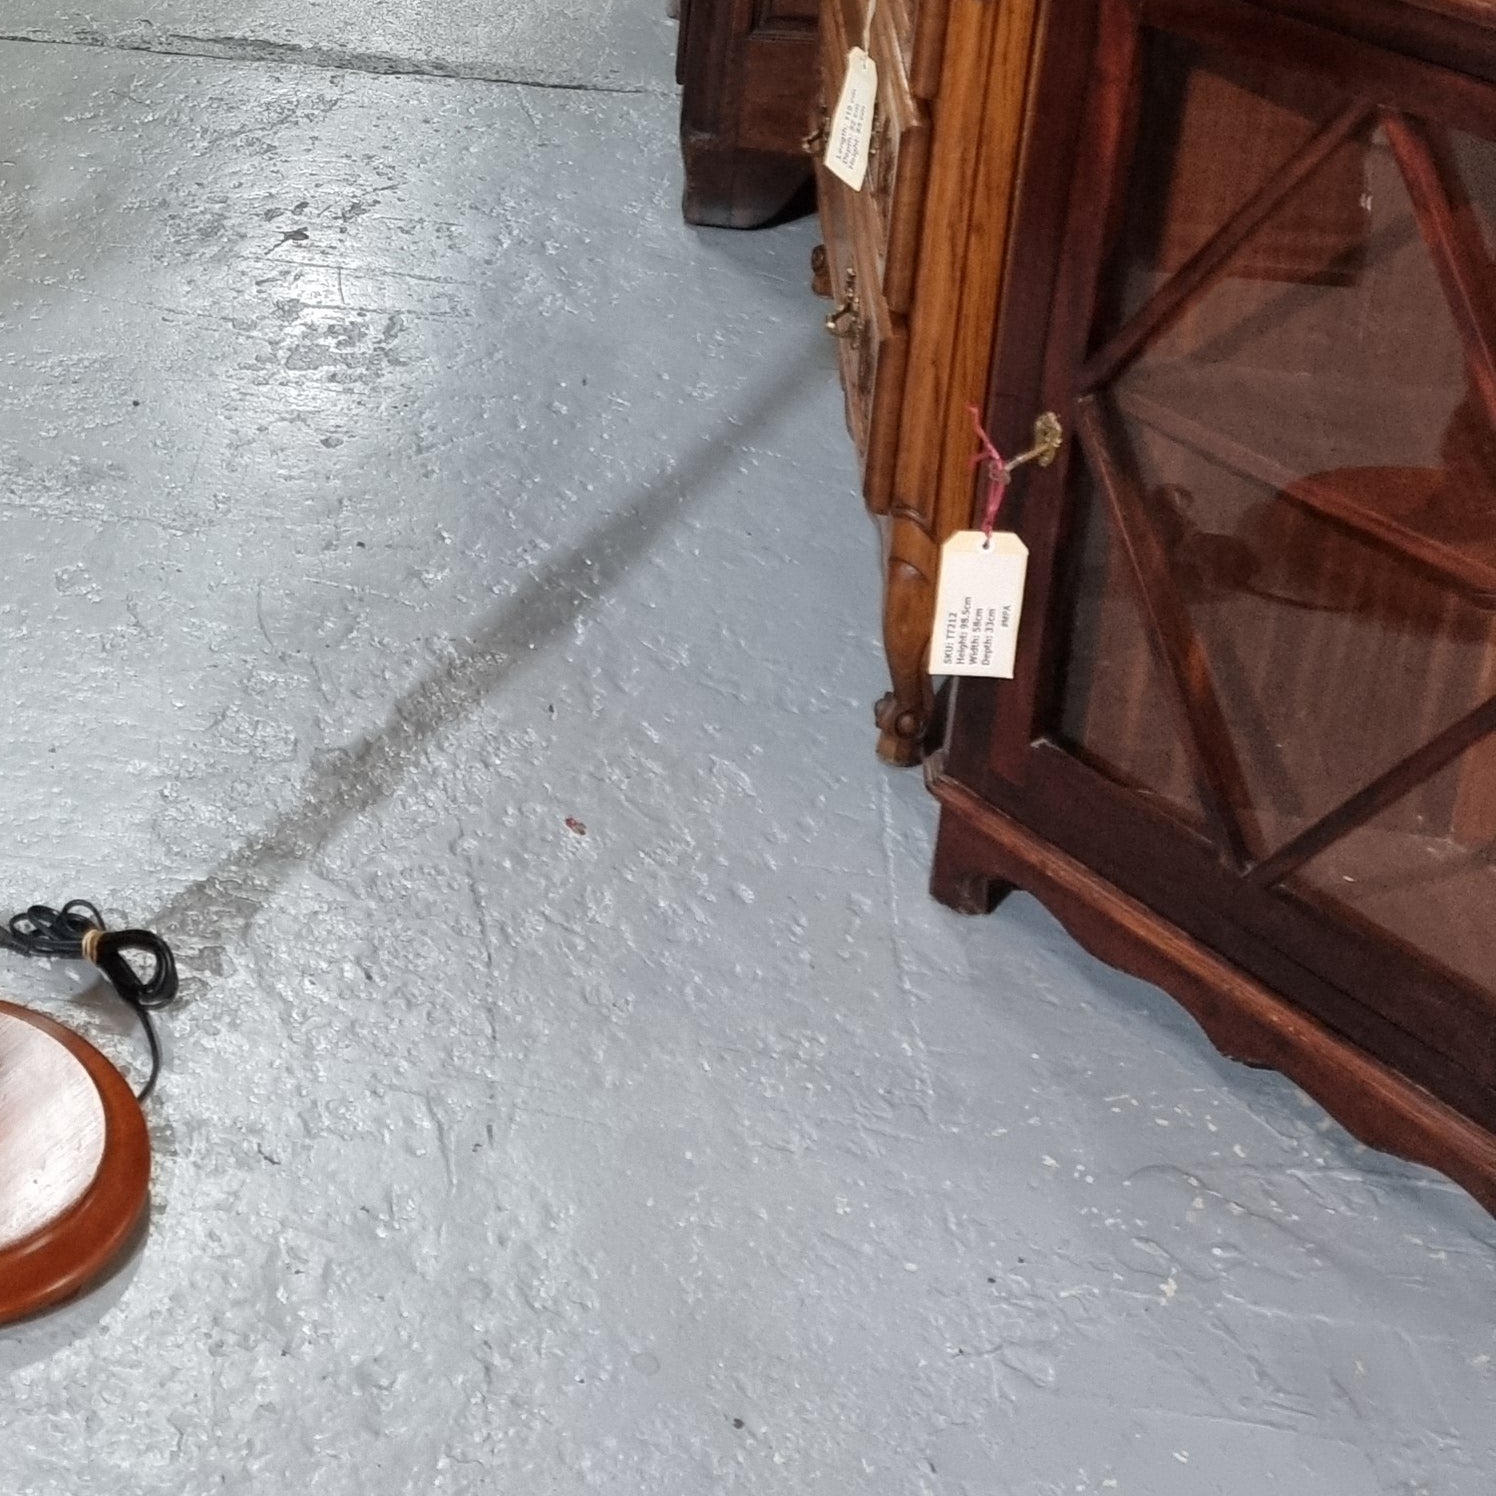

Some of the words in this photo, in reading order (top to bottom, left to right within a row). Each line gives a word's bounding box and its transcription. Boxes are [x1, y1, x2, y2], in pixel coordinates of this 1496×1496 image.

[944, 642, 954, 664] SKU:
[956, 632, 968, 665] Height:
[969, 635, 980, 665] Width:
[981, 635, 993, 666] Depth:
